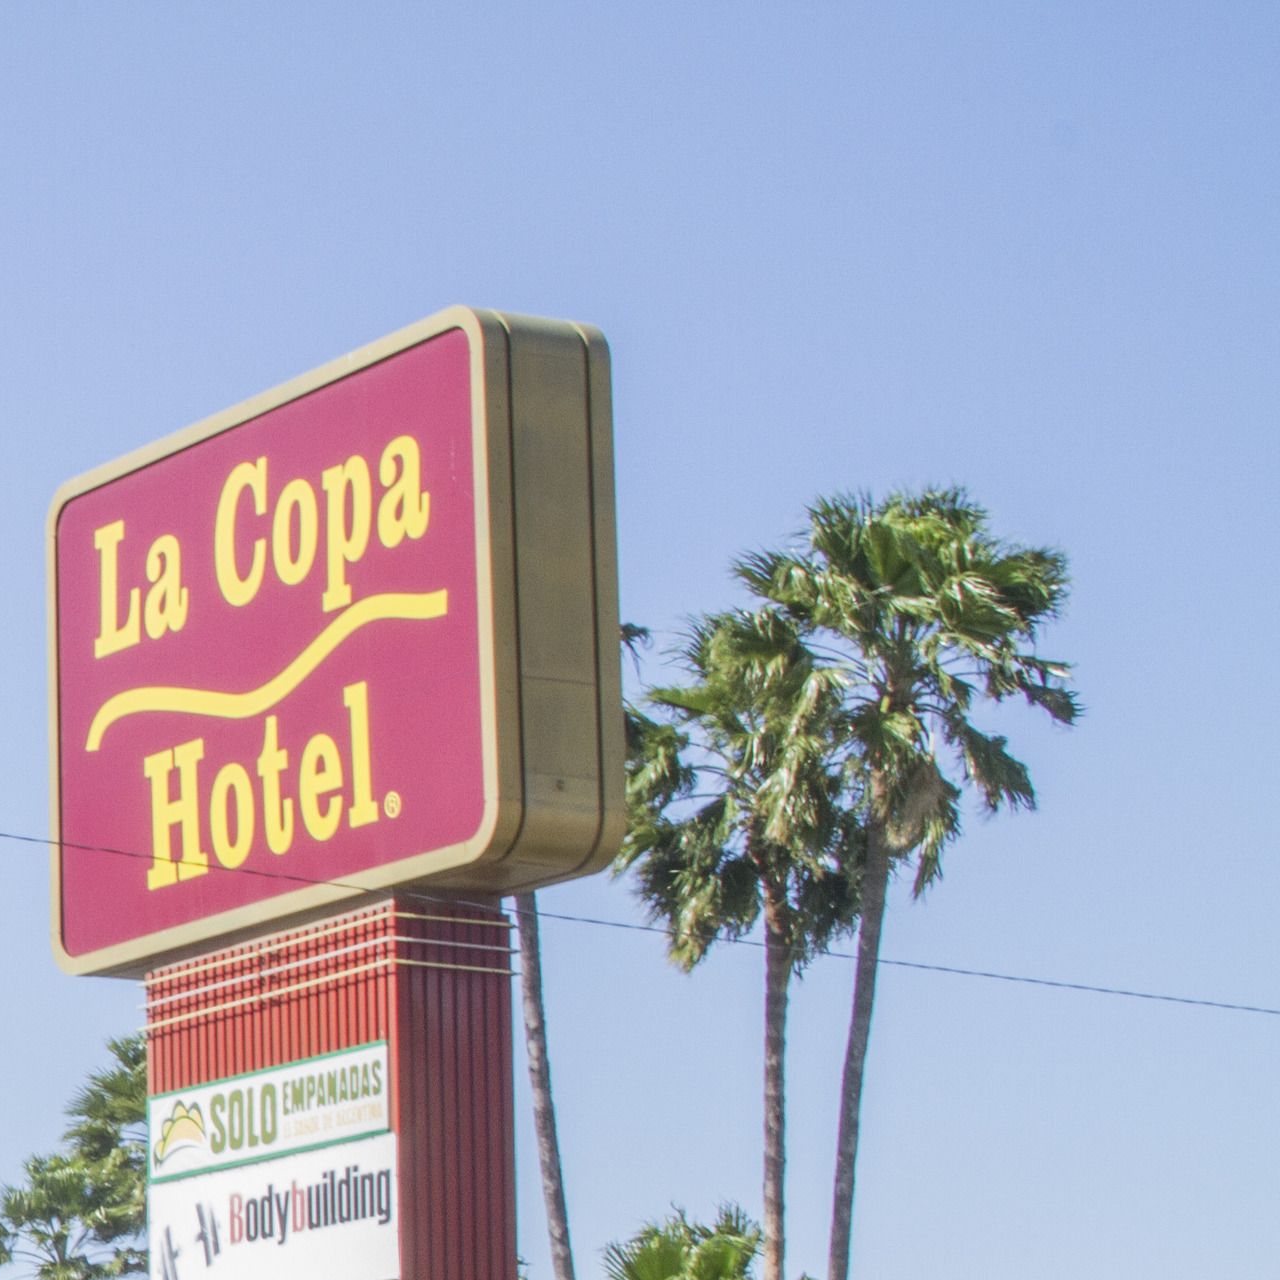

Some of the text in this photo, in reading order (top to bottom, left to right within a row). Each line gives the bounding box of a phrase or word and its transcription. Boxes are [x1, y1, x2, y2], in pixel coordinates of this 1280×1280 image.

[94, 435, 430, 659] La Copa
[144, 681, 379, 891] Hotel
[209, 1059, 382, 1154] SOLO EMPANADAS
[229, 1165, 392, 1245] Bodybuilding
